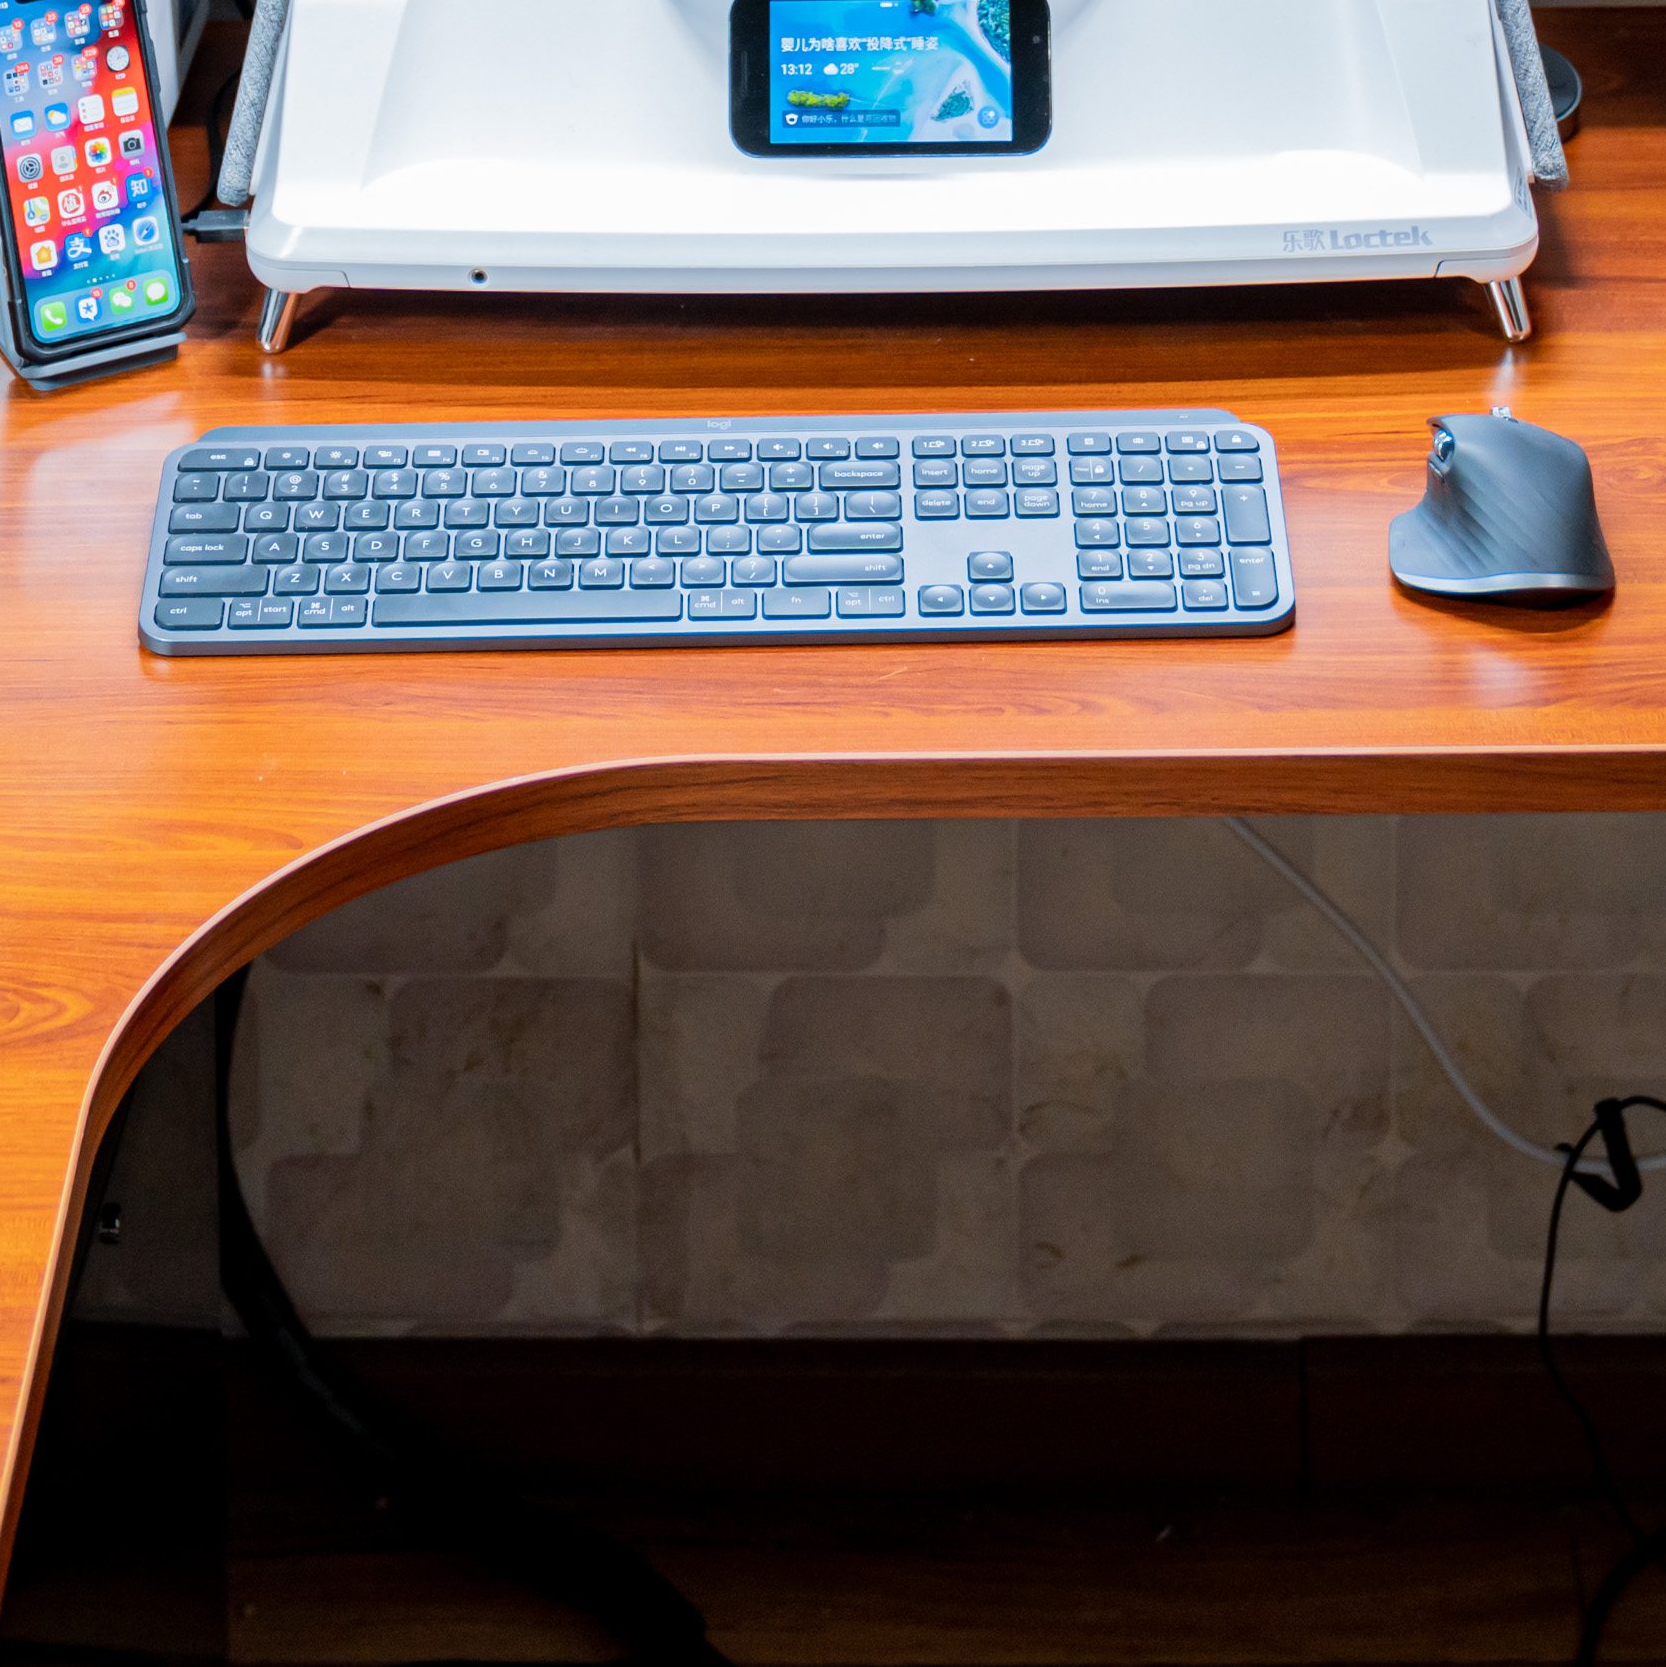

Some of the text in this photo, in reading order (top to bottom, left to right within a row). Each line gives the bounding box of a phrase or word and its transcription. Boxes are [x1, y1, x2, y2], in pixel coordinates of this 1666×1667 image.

[781, 63, 860, 75] 13:12 28°
[130, 179, 149, 197] 知
[62, 195, 80, 213] 值
[1283, 226, 1434, 252] 乐歌 Loctek
[67, 236, 93, 258] 支
[706, 419, 732, 431] logi
[210, 453, 227, 461] esc
[834, 469, 884, 479] backspace
[921, 463, 1046, 476] insert home page
[1028, 470, 1041, 478] up
[921, 494, 1049, 507] delete end page
[1023, 499, 1050, 508] down
[1080, 500, 1108, 509] home
[1181, 499, 1208, 508] pg up
[185, 511, 202, 520] tab
[259, 503, 721, 521] Q W E R T Y U O P
[860, 532, 885, 540] enter
[180, 542, 224, 553] caps lock
[1239, 555, 1265, 565] enter
[864, 562, 887, 572] shift
[1091, 564, 1110, 572] end
[1187, 560, 1215, 571] pg dn
[175, 574, 197, 584] shift
[694, 596, 745, 609] cmd alt
[790, 595, 802, 604] fn
[845, 594, 895, 607] opt ctrl
[1095, 596, 1109, 604] ins
[1198, 594, 1213, 602] del
[169, 606, 187, 615] ctrl
[235, 605, 287, 617] opt start
[303, 603, 355, 615] cmd alt
